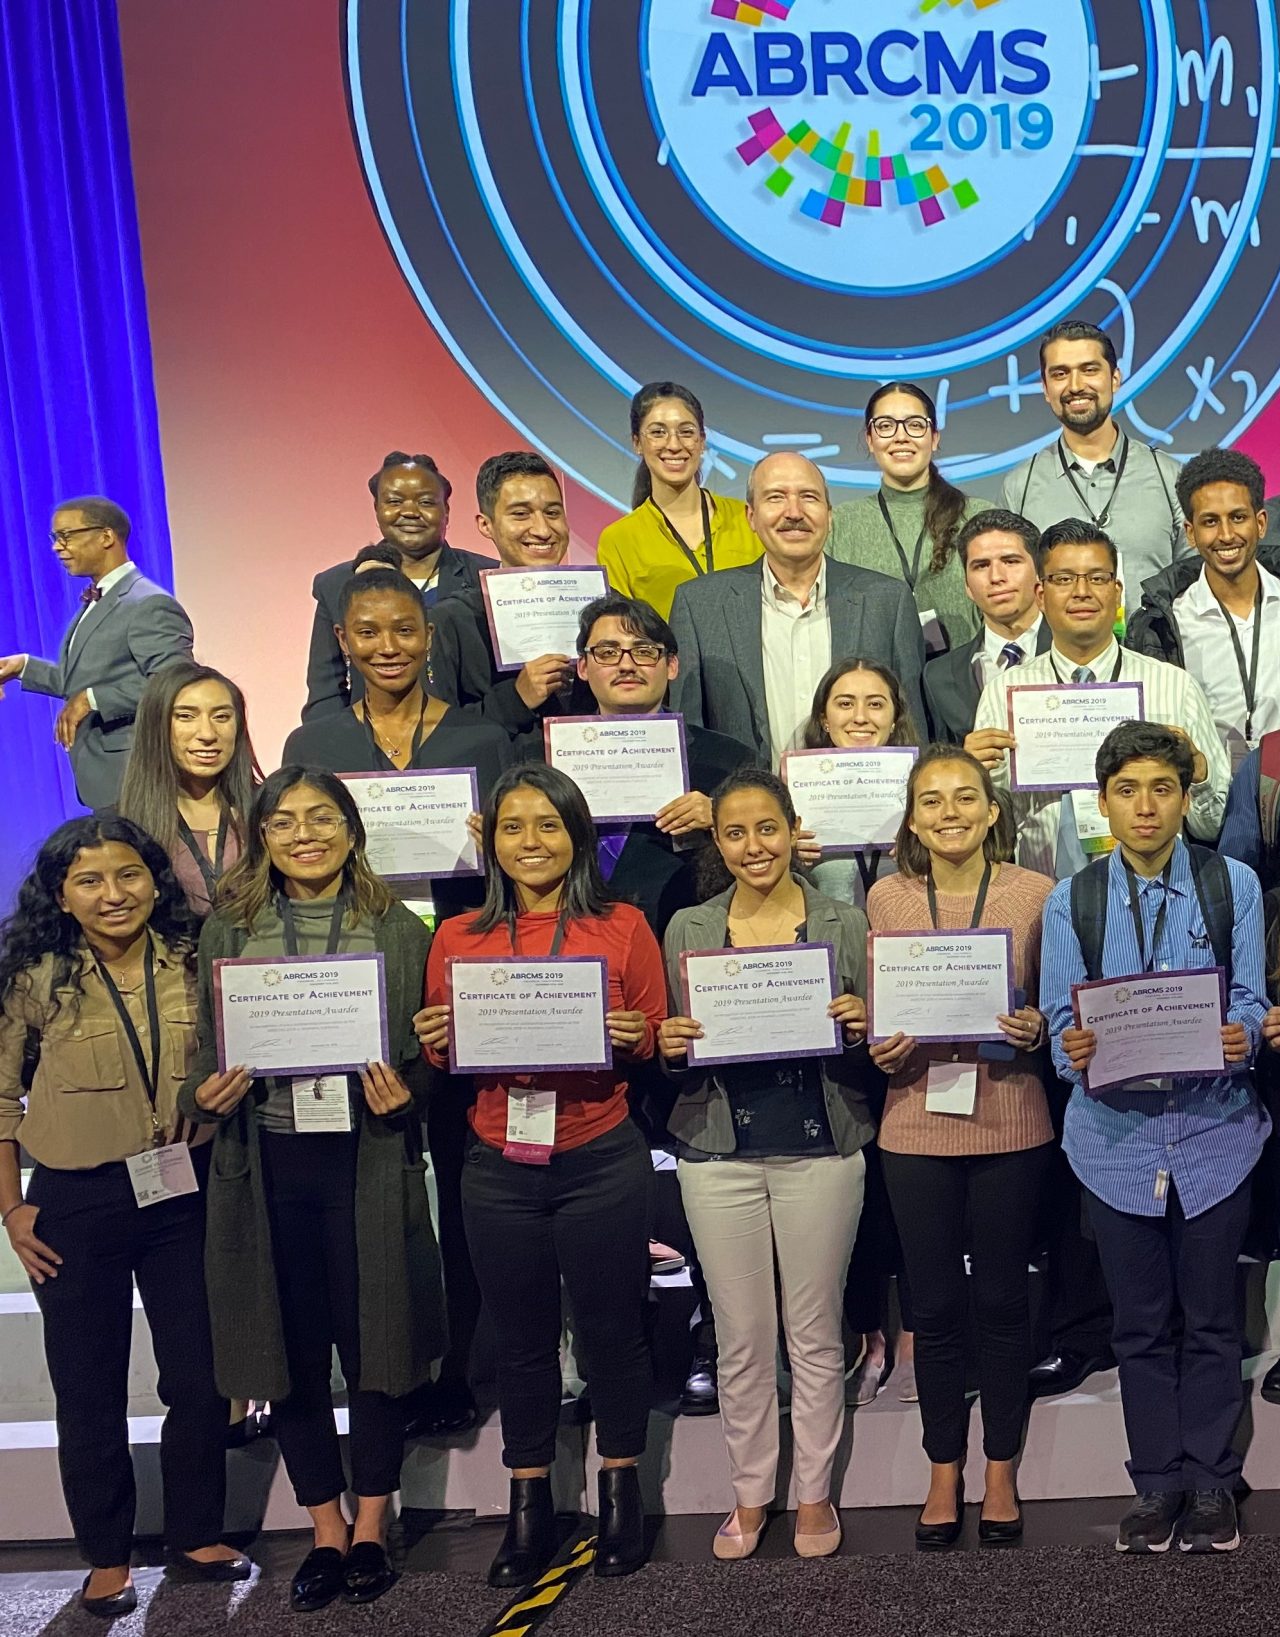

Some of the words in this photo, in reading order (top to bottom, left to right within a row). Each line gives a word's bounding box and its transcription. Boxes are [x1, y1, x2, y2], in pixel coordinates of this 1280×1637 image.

[691, 28, 1052, 97] ABRCMS
[909, 102, 1054, 151] 2019
[410, 802, 467, 810] ACHIEVEMENT
[695, 983, 748, 992] CERTIFICATE
[767, 978, 825, 987] ACHIEVEMENT
[896, 980, 913, 988] 2019
[229, 994, 289, 1003] CERTIFICATE
[309, 989, 373, 999] ACHIEVEMENT
[460, 992, 515, 1000] CERTIFICATE
[535, 991, 596, 999] ACHIEVEMENT
[714, 999, 731, 1007] 2019
[734, 996, 779, 1005] Presentation
[249, 1010, 270, 1018] 2019
[272, 1008, 321, 1017] Presentation
[478, 1008, 497, 1016] 2019
[499, 1007, 546, 1015] Presentation
[1087, 1008, 1138, 1024] CERTIFICATE
[1156, 1002, 1215, 1012] ACHIEVEMENT
[1105, 1025, 1122, 1035] 2019
[1123, 1020, 1169, 1031] Presentation
